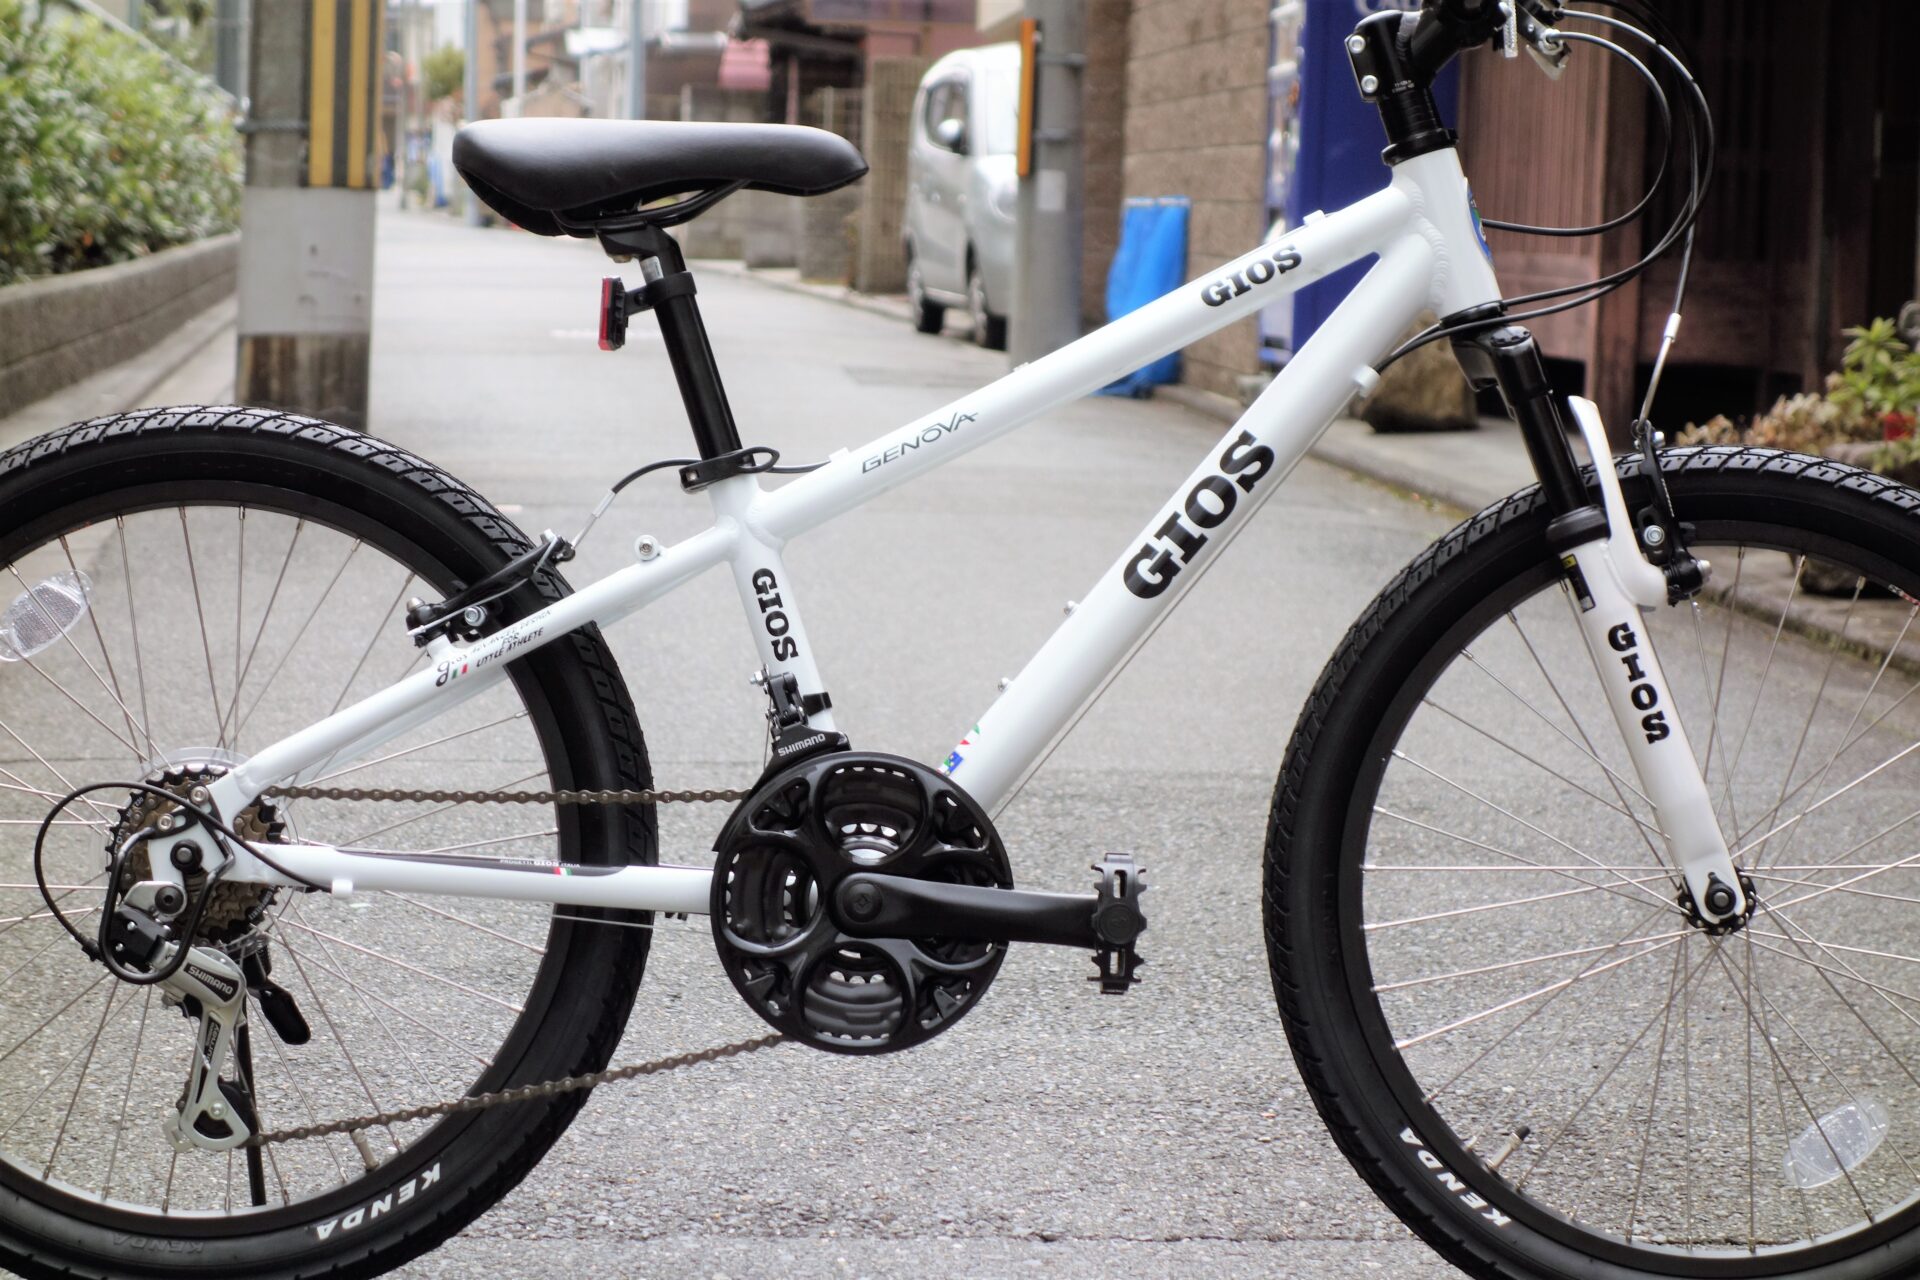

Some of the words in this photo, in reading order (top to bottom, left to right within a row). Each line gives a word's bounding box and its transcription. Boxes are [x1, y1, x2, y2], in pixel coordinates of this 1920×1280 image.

[1201, 244, 1302, 307] GIOS
[862, 412, 978, 474] GENOVA
[1123, 429, 1275, 599] GIOS
[476, 646, 505, 667] LITTLE
[507, 627, 544, 653] ATHLETE
[751, 568, 799, 662] GIOS
[1608, 622, 1670, 744] GIOS
[778, 733, 826, 757] SHIMANO
[187, 966, 234, 995] SHIMANO
[316, 1162, 441, 1241] KENDA
[1400, 1127, 1512, 1227] KENDA
